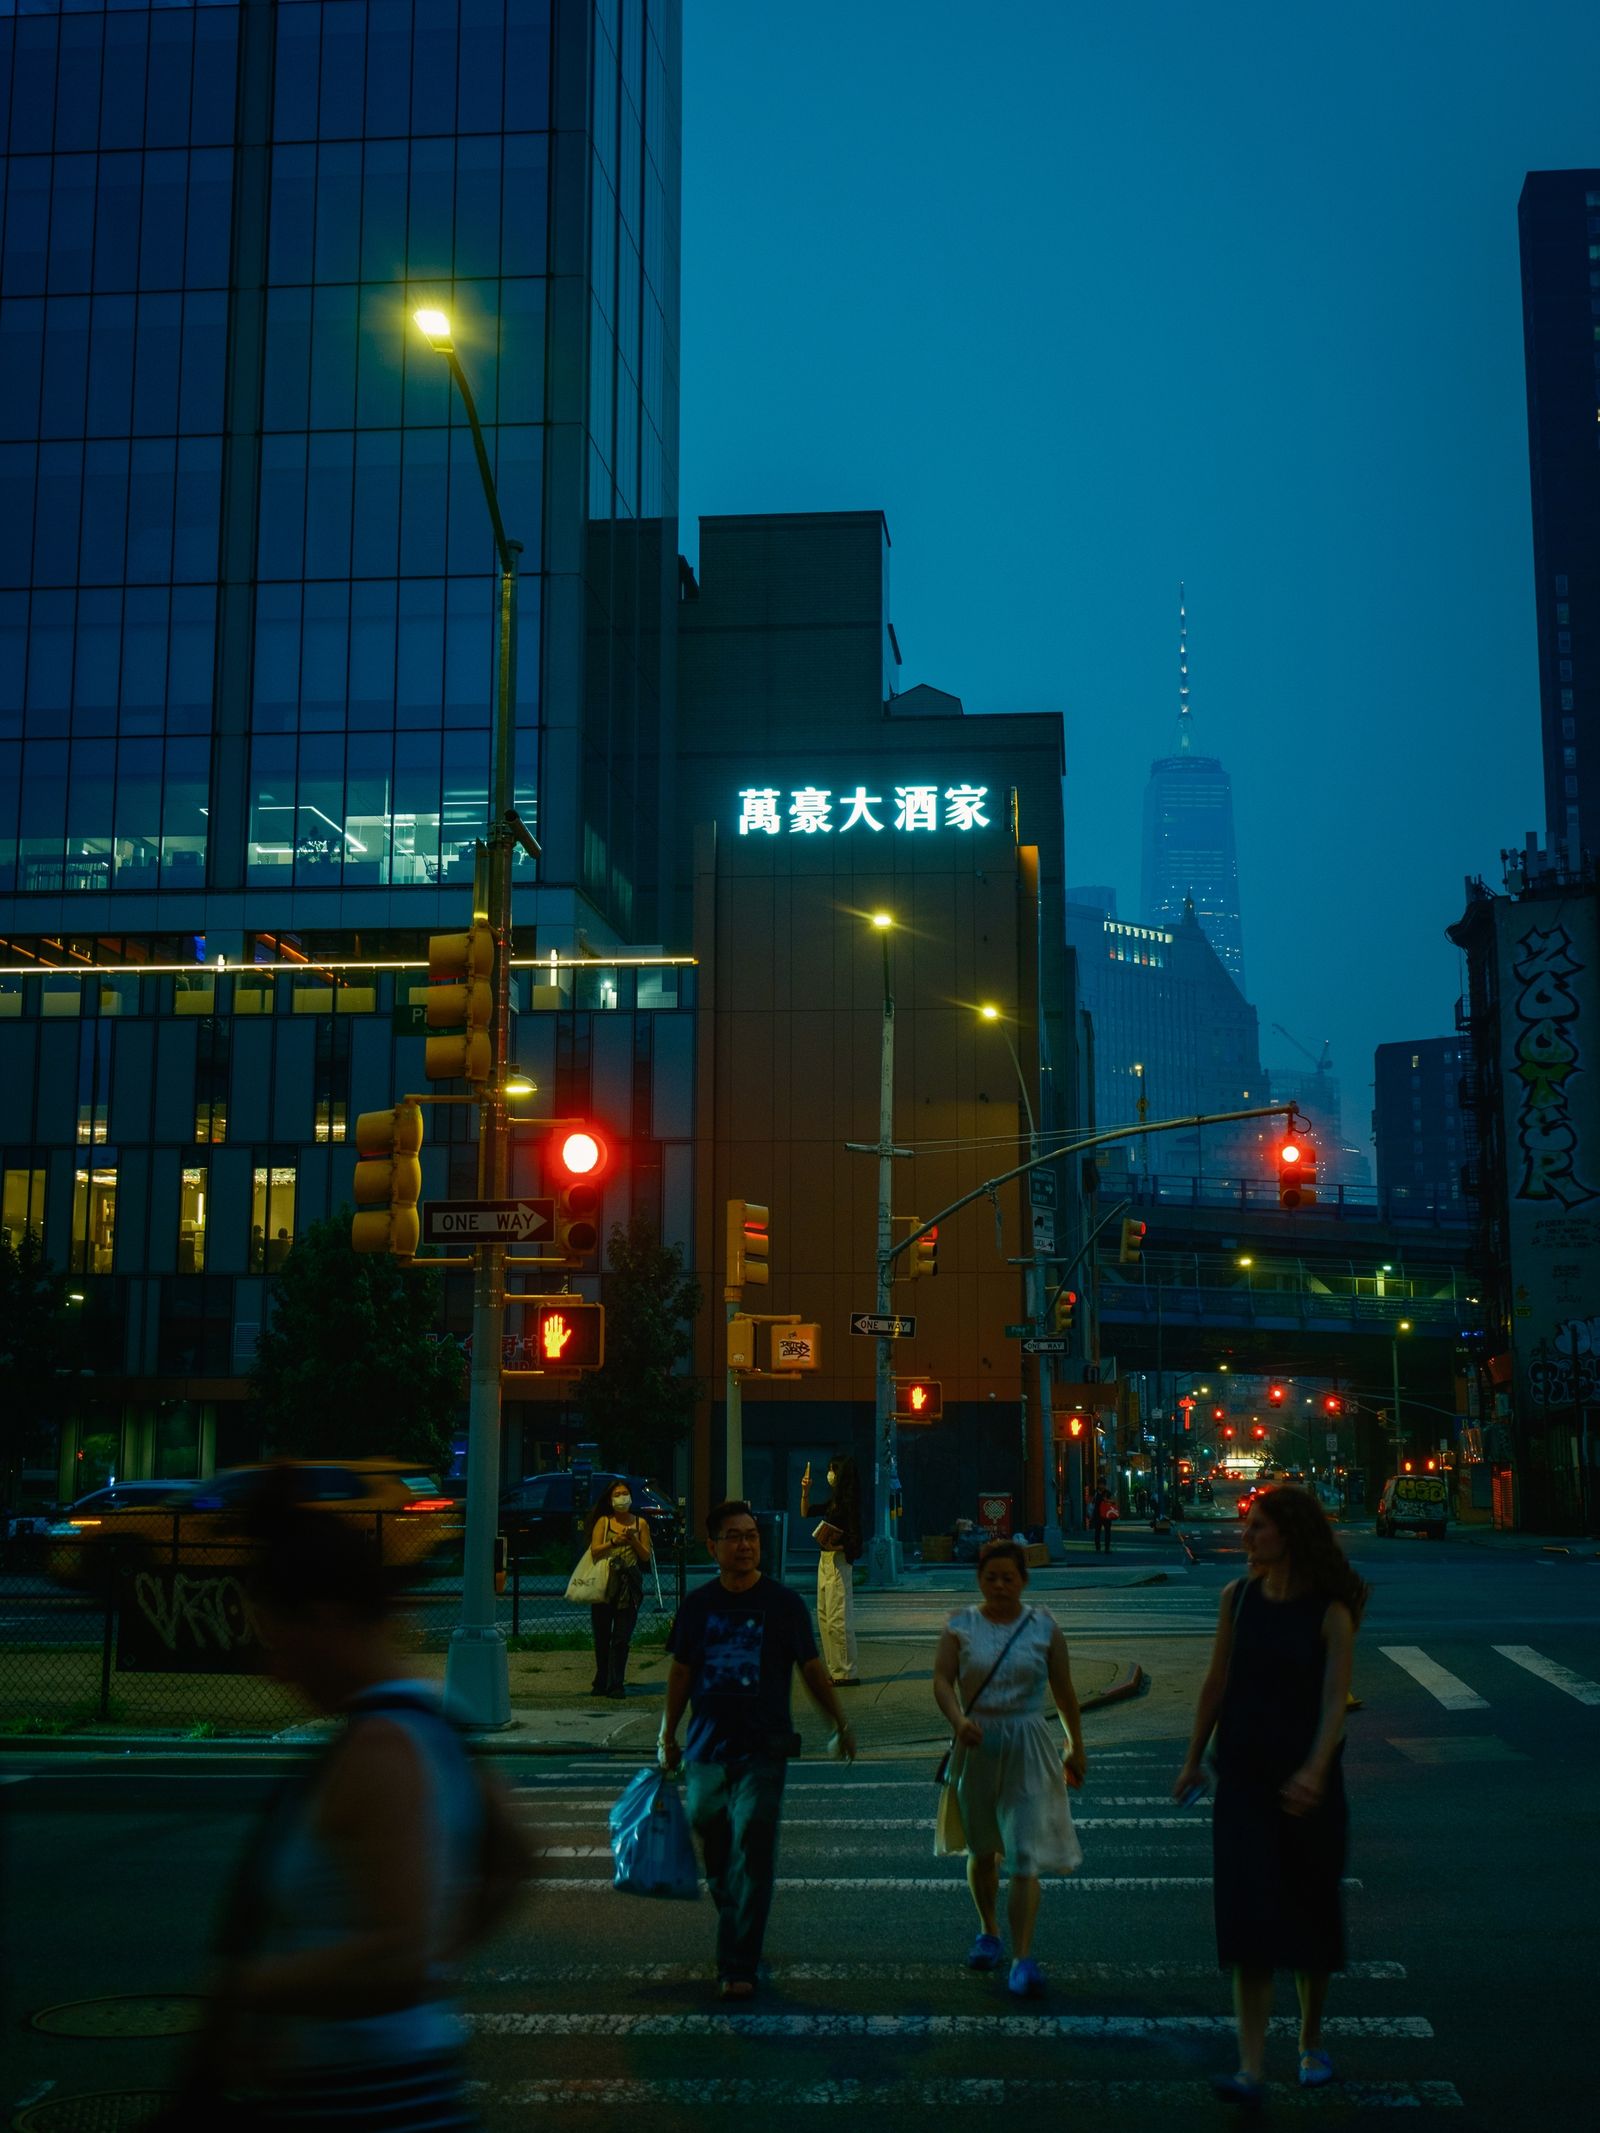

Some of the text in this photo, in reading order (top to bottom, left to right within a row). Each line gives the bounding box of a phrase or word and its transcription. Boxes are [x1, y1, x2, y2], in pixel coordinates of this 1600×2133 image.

[738, 784, 991, 836] 萬豪大酒家
[442, 1213, 535, 1231] ONE WAY
[860, 1320, 907, 1331] ONE WAY
[1027, 1342, 1040, 1350] ONE
